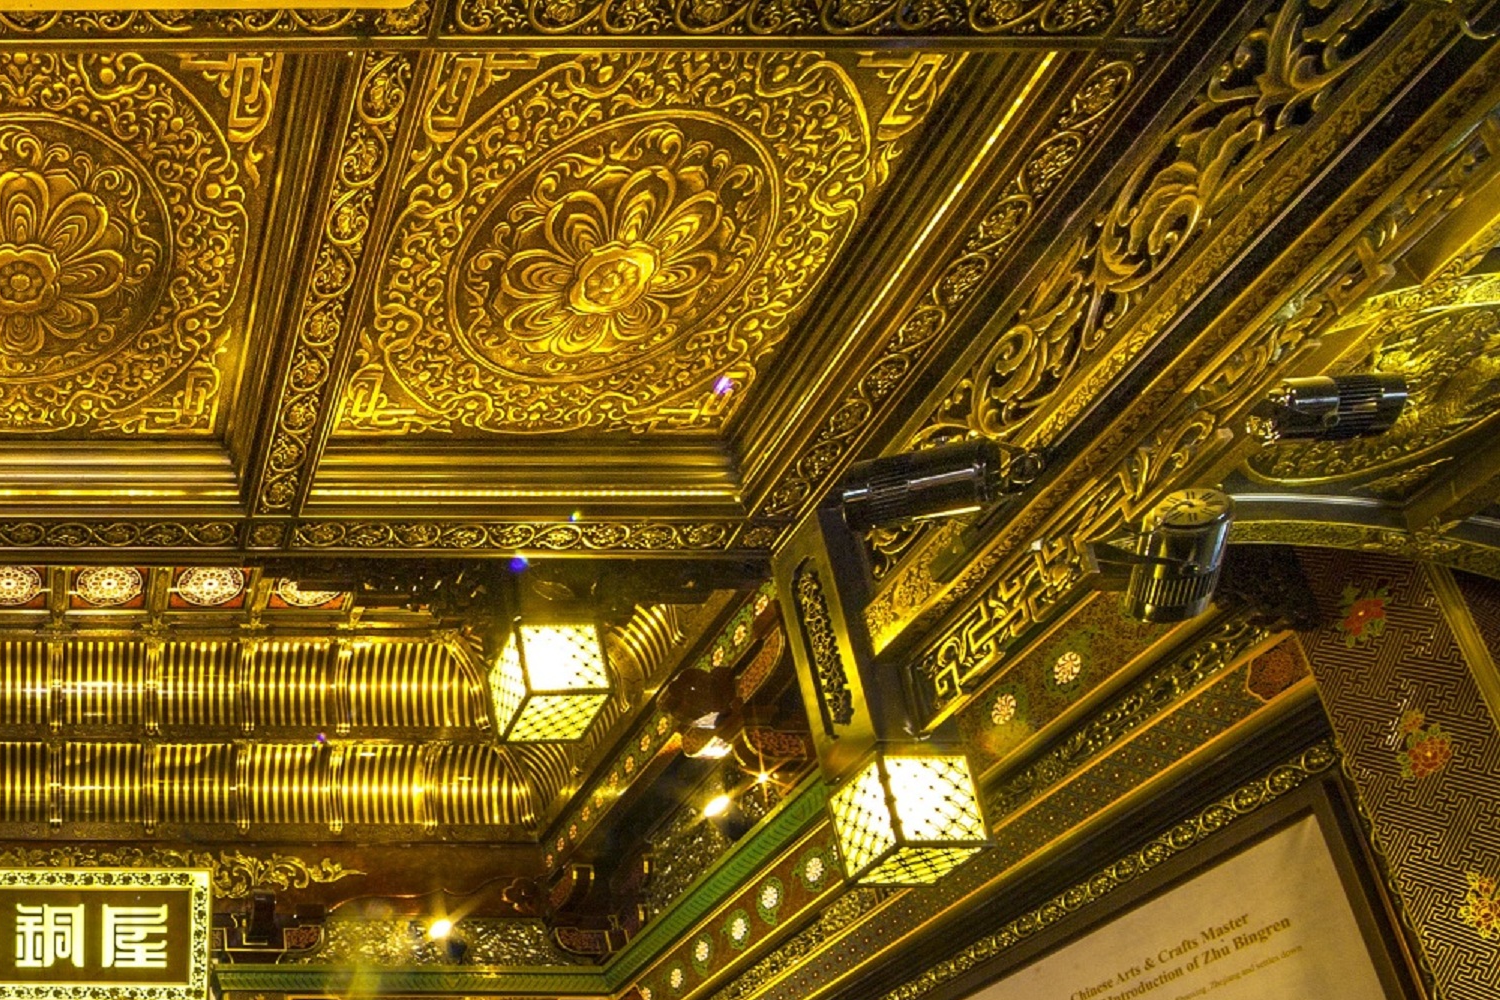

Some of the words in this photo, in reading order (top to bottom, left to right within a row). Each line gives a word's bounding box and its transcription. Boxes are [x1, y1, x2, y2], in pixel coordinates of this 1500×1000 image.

[1116, 966, 1141, 983] Arts
[1143, 957, 1156, 970] &
[1156, 937, 1199, 964] Crafts
[1201, 914, 1250, 943] Master
[1186, 957, 1200, 972] of
[1201, 944, 1230, 964] Zhu
[1233, 918, 1291, 950] Bingren
